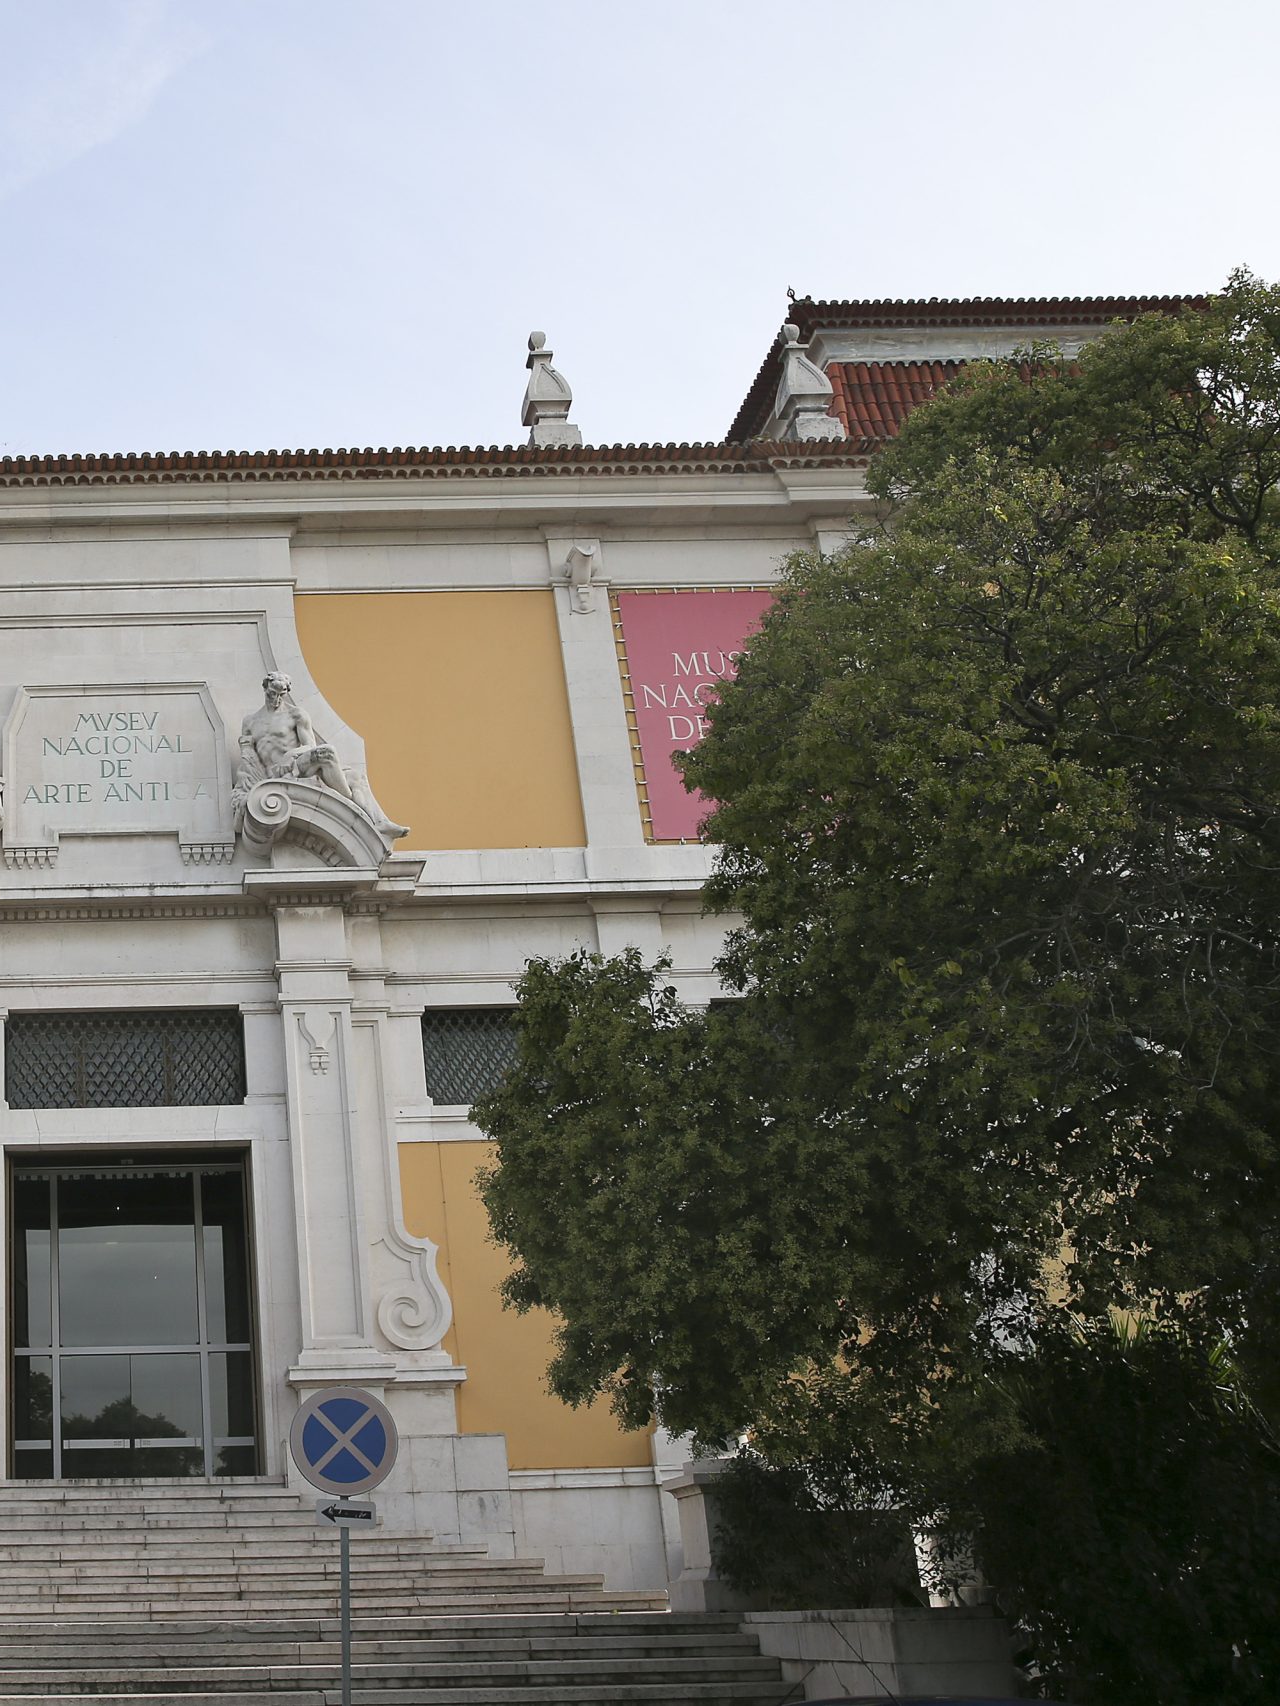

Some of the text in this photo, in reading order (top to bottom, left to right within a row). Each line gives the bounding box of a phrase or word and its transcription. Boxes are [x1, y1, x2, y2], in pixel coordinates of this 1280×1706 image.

[672, 651, 752, 677] MUS
[640, 682, 719, 709] NAC
[74, 711, 159, 732] MVSEV
[42, 735, 192, 756] NACIONAL
[100, 759, 133, 779] DE
[23, 783, 93, 804] ARTE
